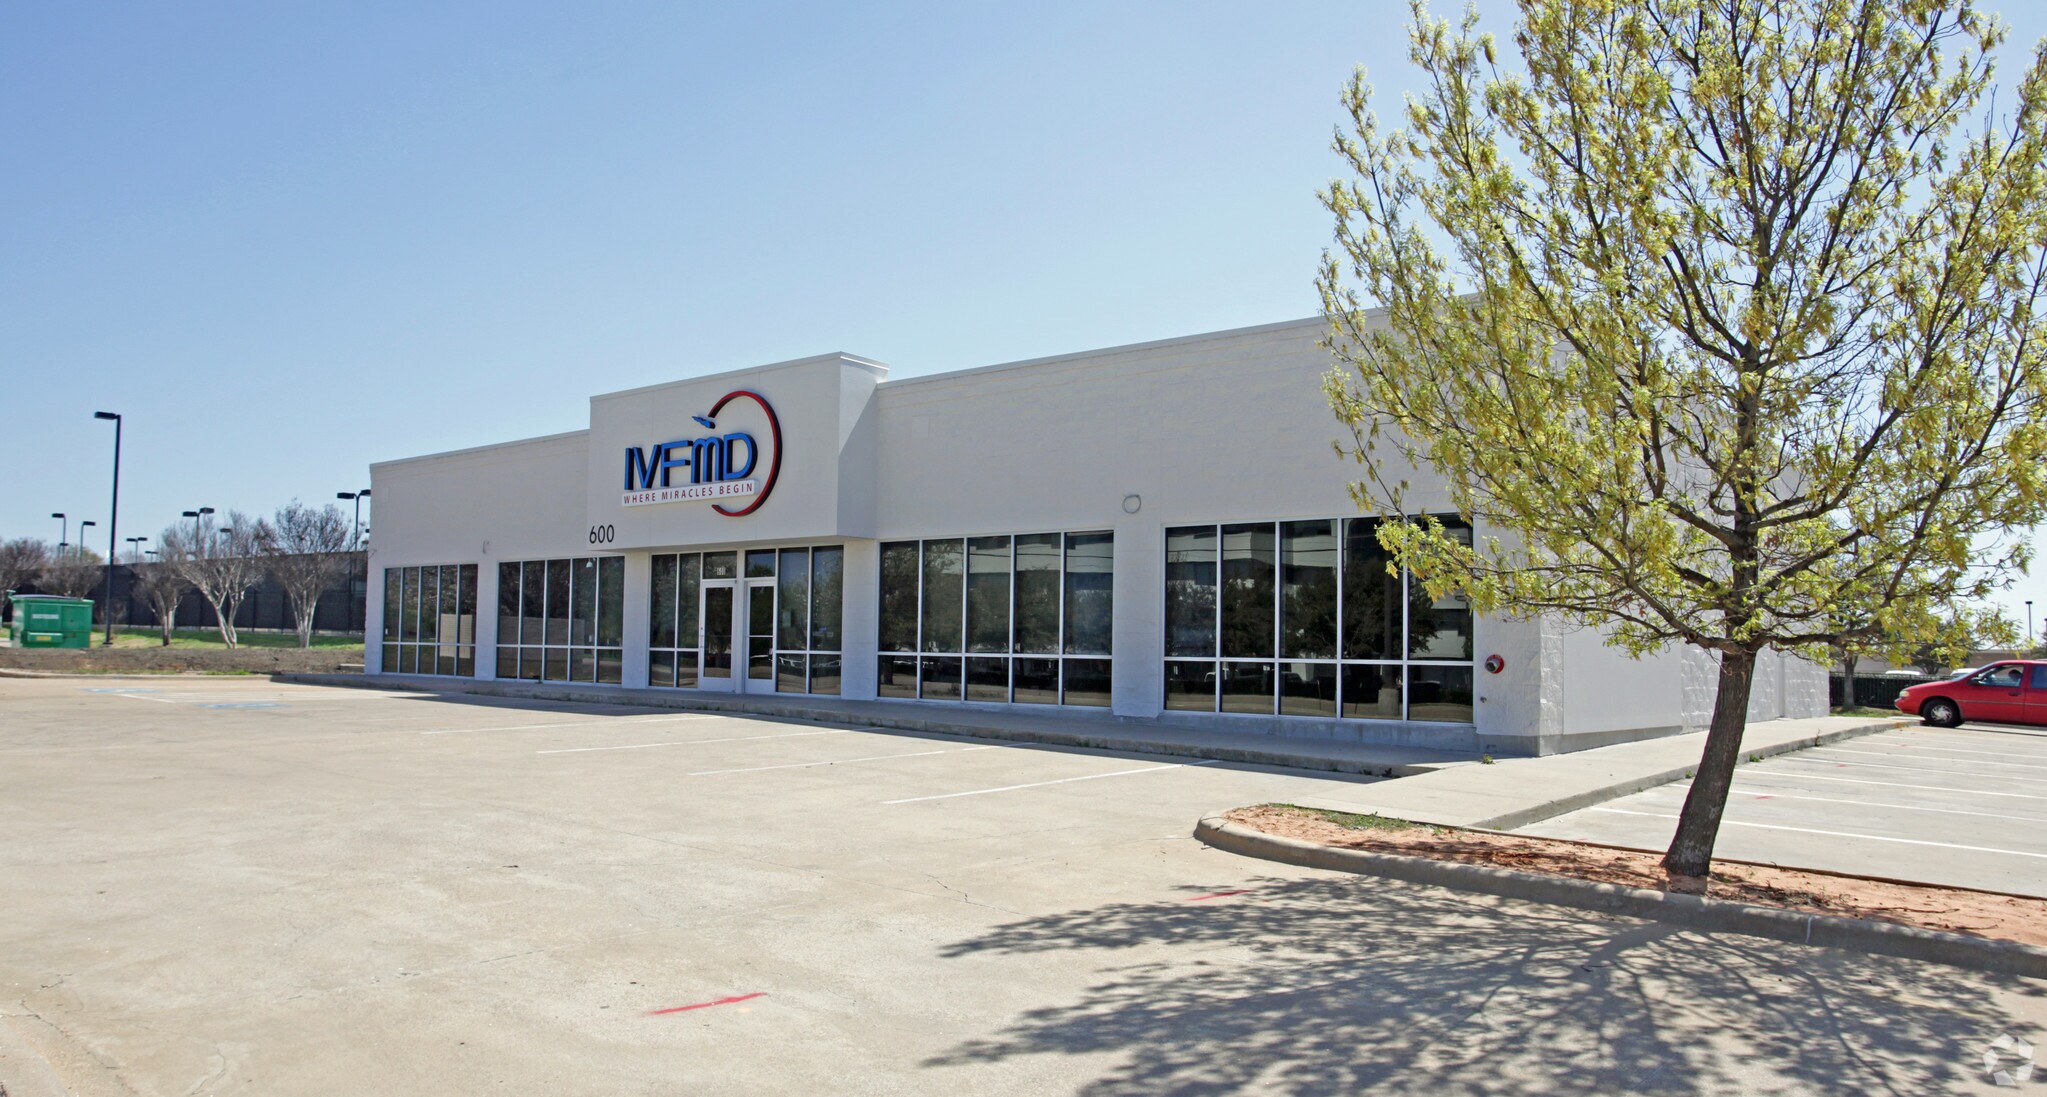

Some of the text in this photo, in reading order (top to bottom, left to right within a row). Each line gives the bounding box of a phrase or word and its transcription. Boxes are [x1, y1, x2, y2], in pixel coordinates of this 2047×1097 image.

[624, 483, 753, 504] WHERE MIRACLES BEGIN
[589, 524, 615, 544] 600
